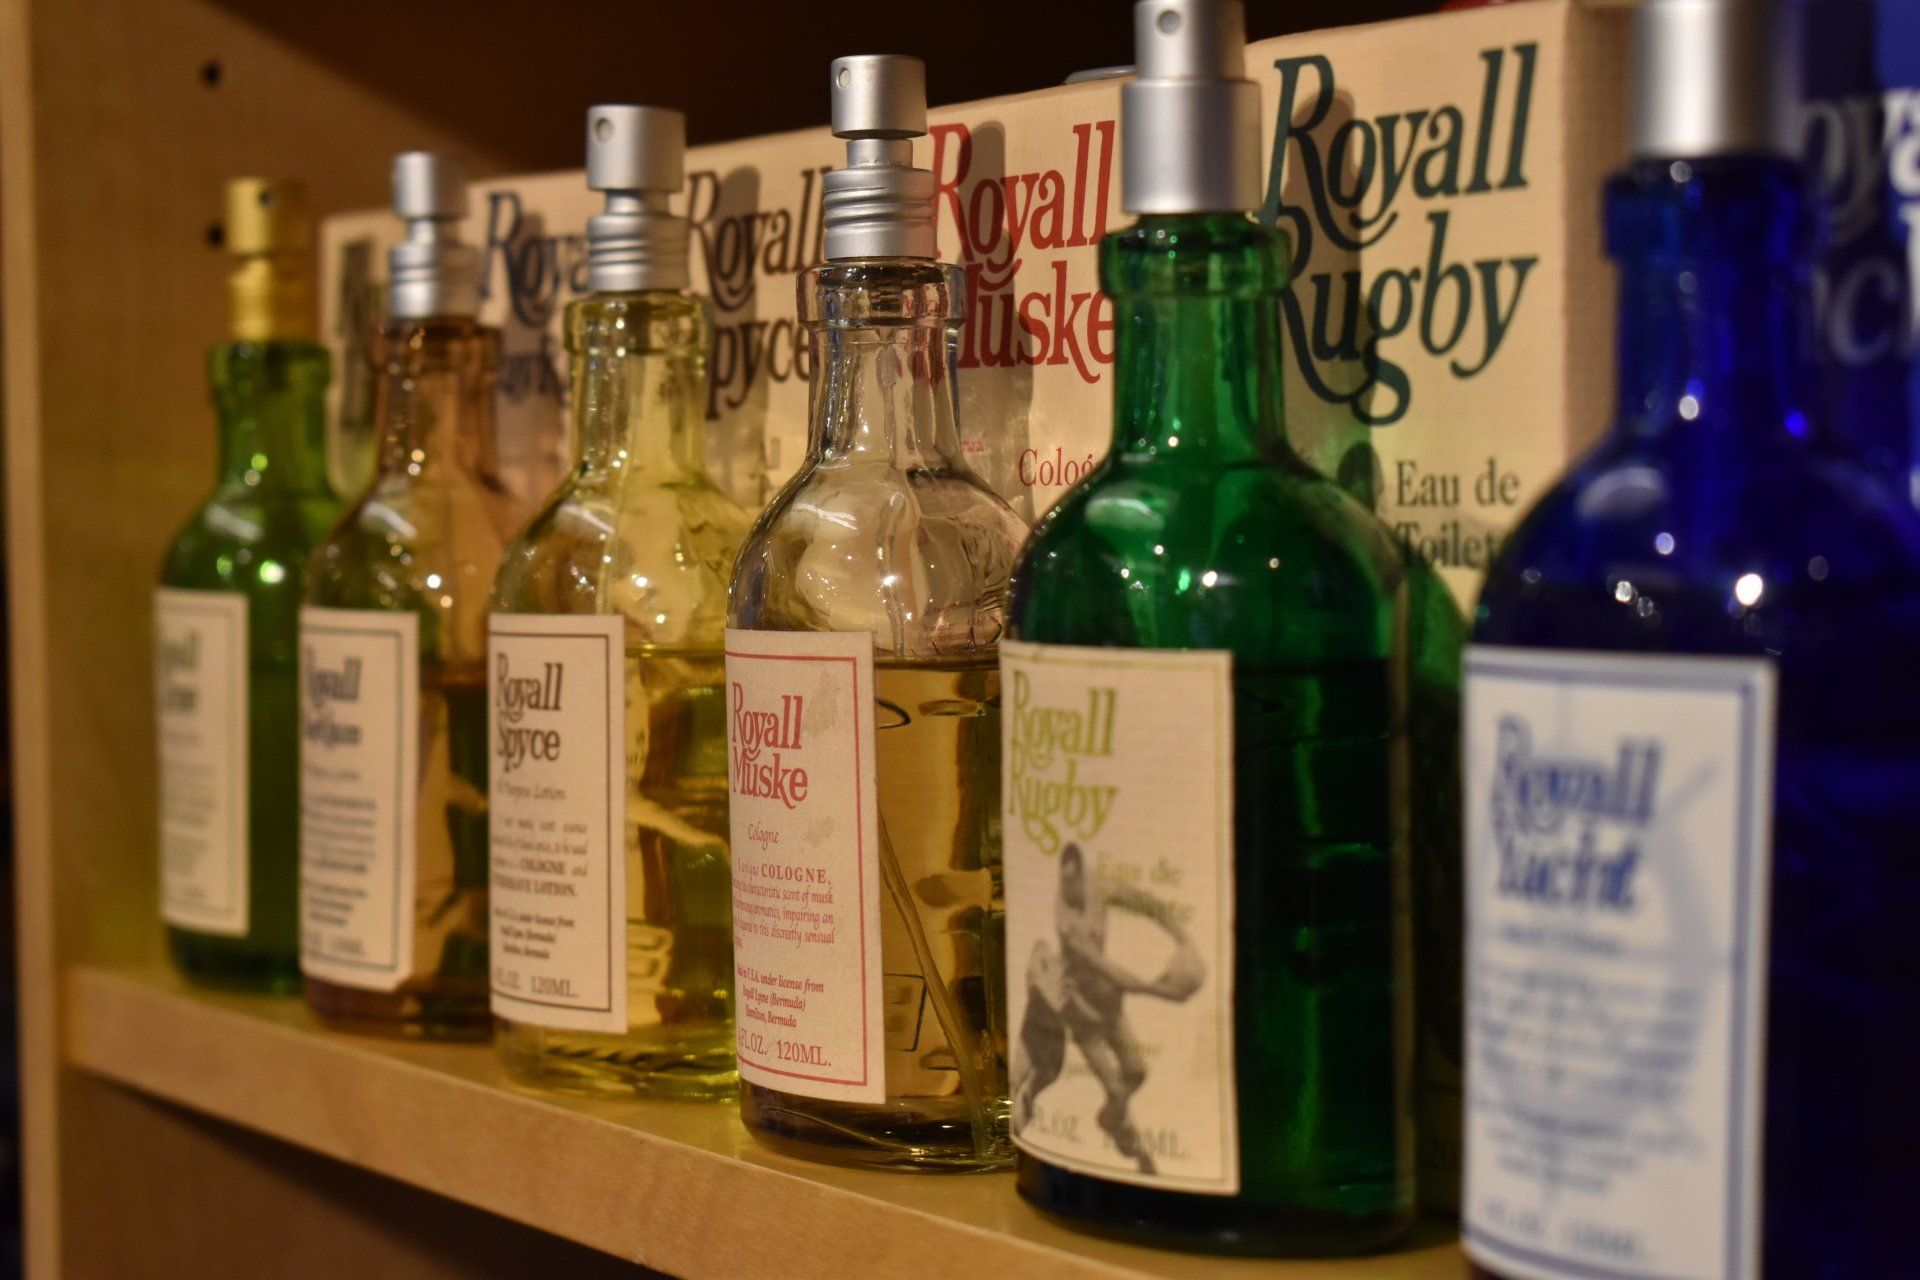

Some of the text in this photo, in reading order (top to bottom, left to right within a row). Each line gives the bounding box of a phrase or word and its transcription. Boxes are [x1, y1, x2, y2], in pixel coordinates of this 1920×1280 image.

[1251, 42, 1539, 252] Royall
[928, 120, 1116, 292] Royall
[478, 191, 590, 329] Roya
[706, 316, 811, 419] pyce
[1395, 455, 1521, 507] Eau de
[732, 682, 803, 761] Royall
[1012, 669, 1117, 771] Royall
[733, 747, 808, 809] Muske
[1008, 740, 1118, 855] Rugby
[804, 926, 836, 944] sensual
[822, 911, 834, 924] an
[760, 972, 778, 986] under
[778, 974, 804, 990] license
[804, 978, 824, 994] from
[770, 992, 806, 1012] (Bermuda)
[767, 1010, 797, 1028] Bermuda
[776, 1039, 832, 1068] 120ML.
